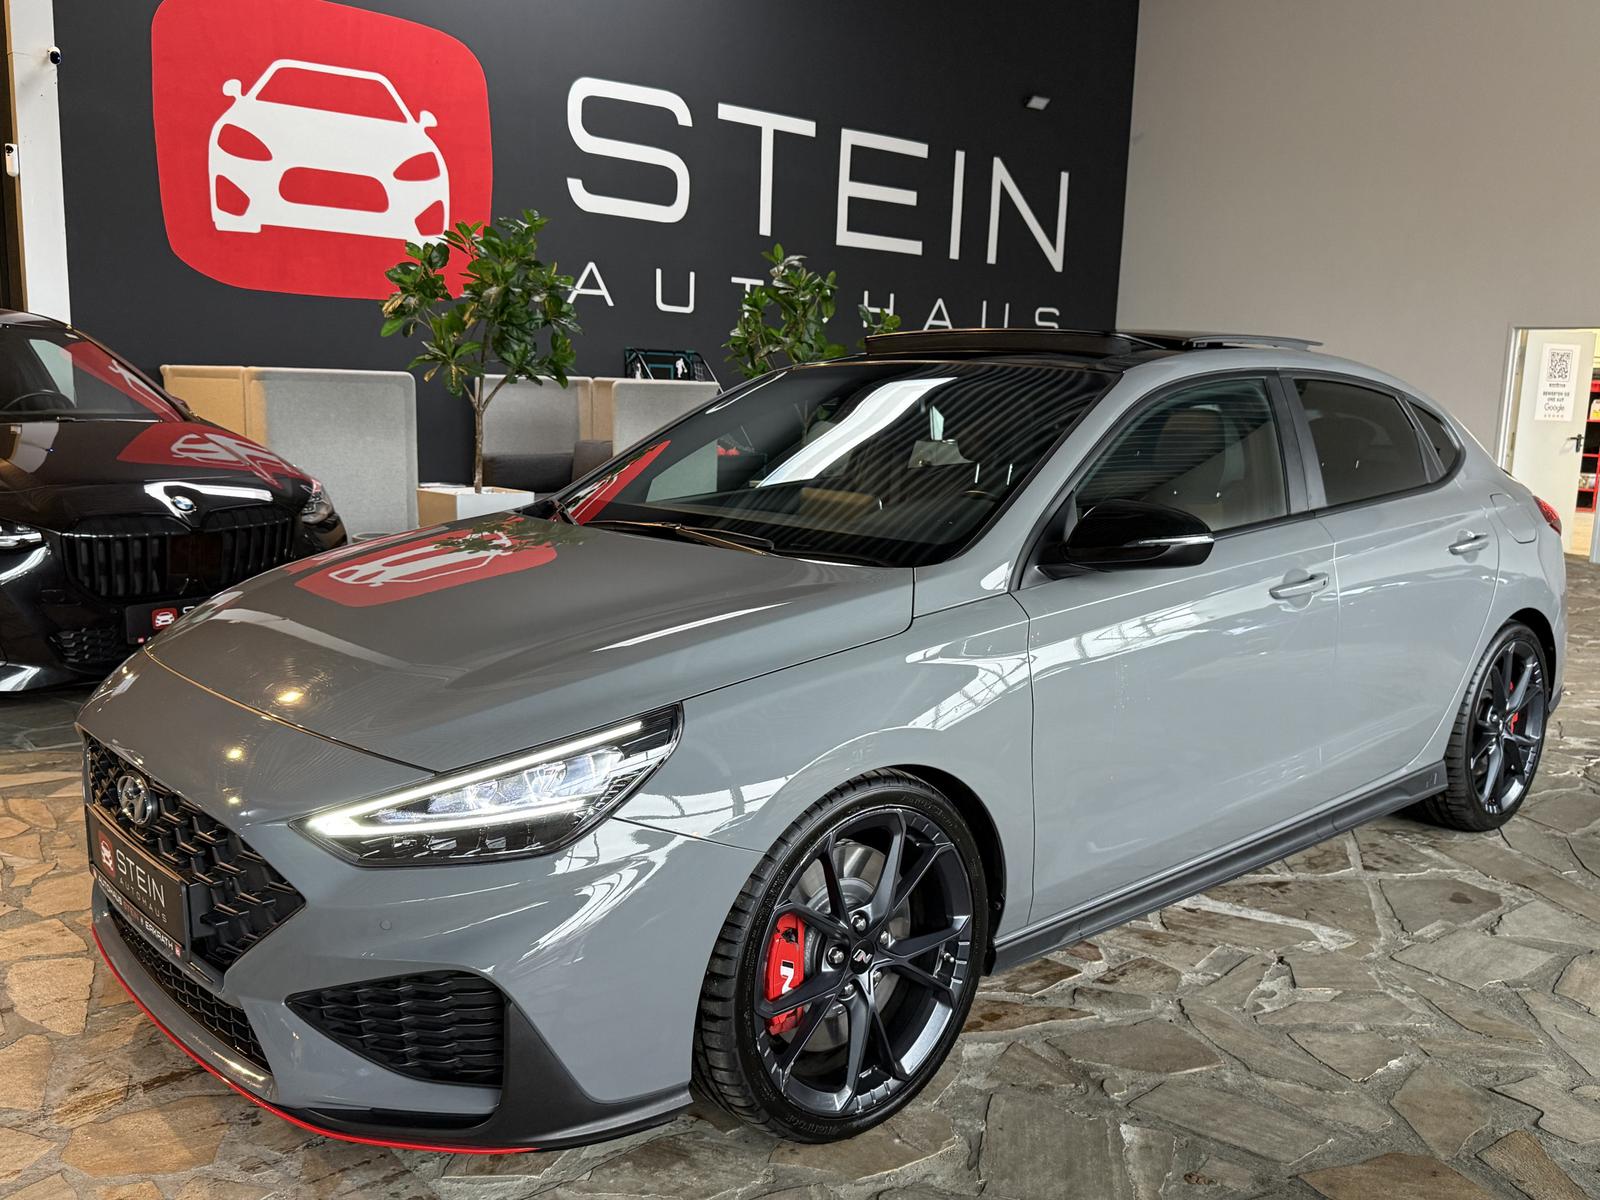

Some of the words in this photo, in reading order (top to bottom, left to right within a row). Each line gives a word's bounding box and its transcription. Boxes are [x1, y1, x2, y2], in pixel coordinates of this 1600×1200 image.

[567, 76, 1069, 273] STEIN
[566, 261, 1060, 330] AUTHAUS
[1544, 402, 1565, 413] Google
[116, 848, 166, 908] STEIN
[118, 876, 168, 923] AUTOHAUS
